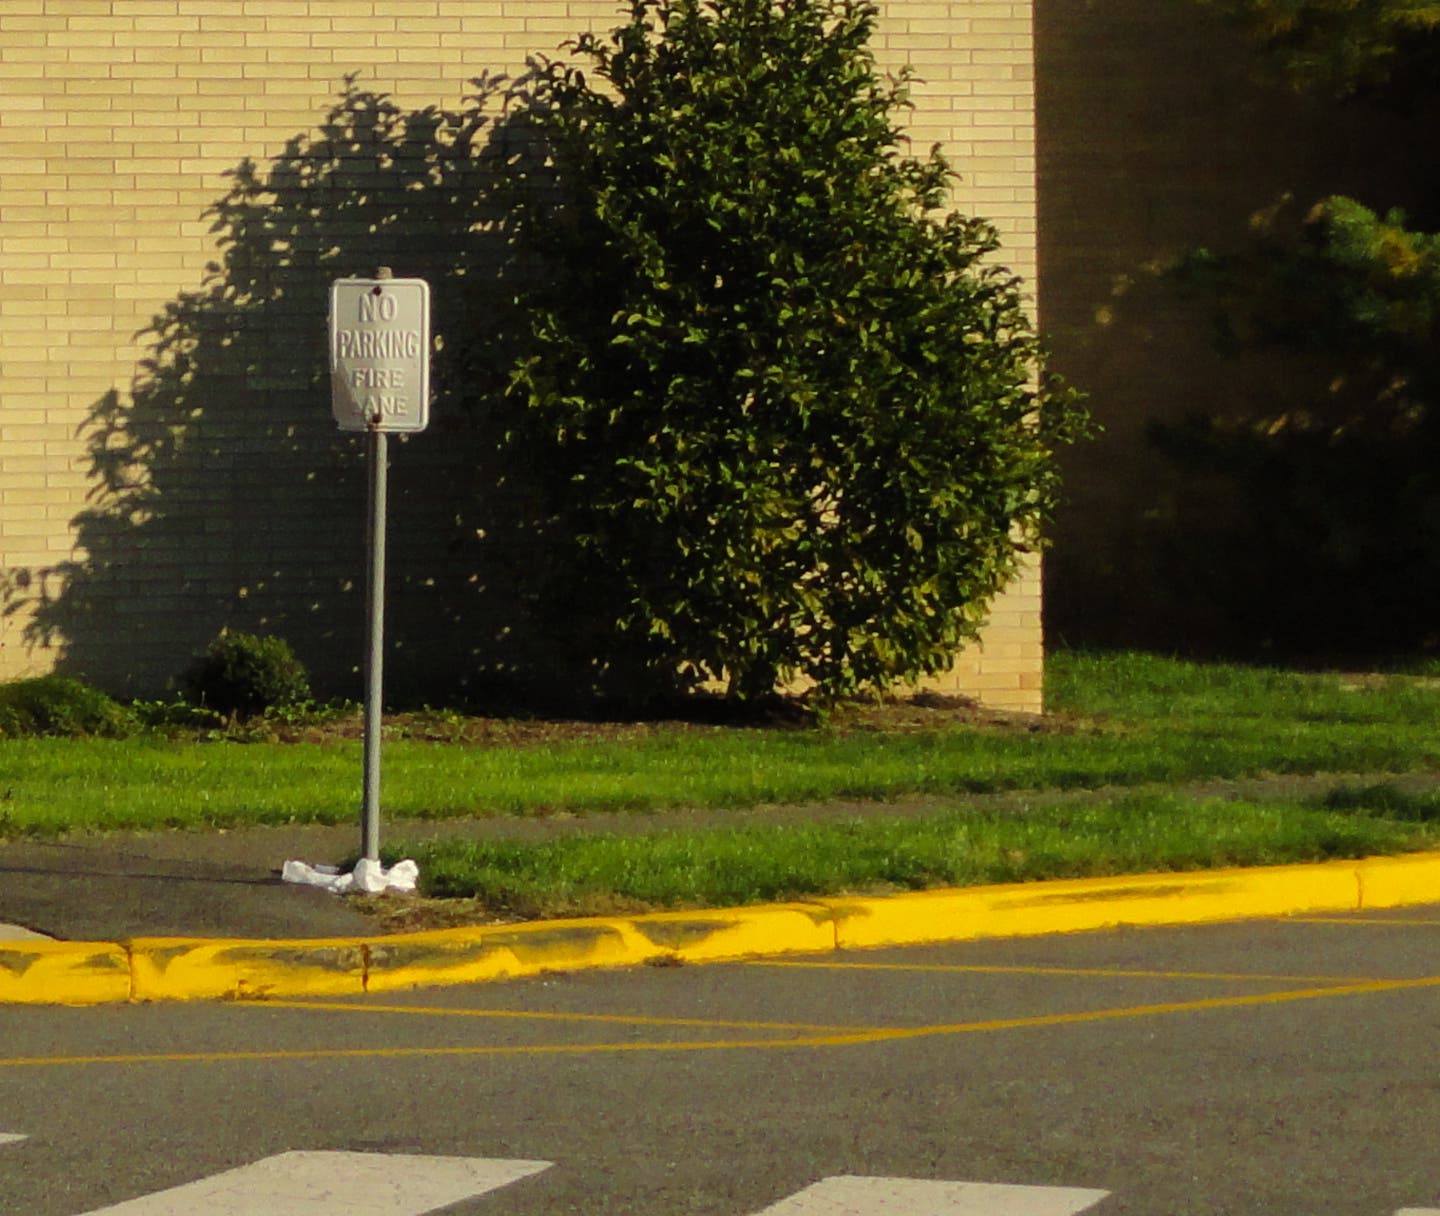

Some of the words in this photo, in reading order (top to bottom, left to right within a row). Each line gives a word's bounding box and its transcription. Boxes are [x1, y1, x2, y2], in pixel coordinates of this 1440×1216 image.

[359, 292, 398, 323] NO
[338, 330, 418, 359] PARKING
[351, 368, 405, 389] FIRE
